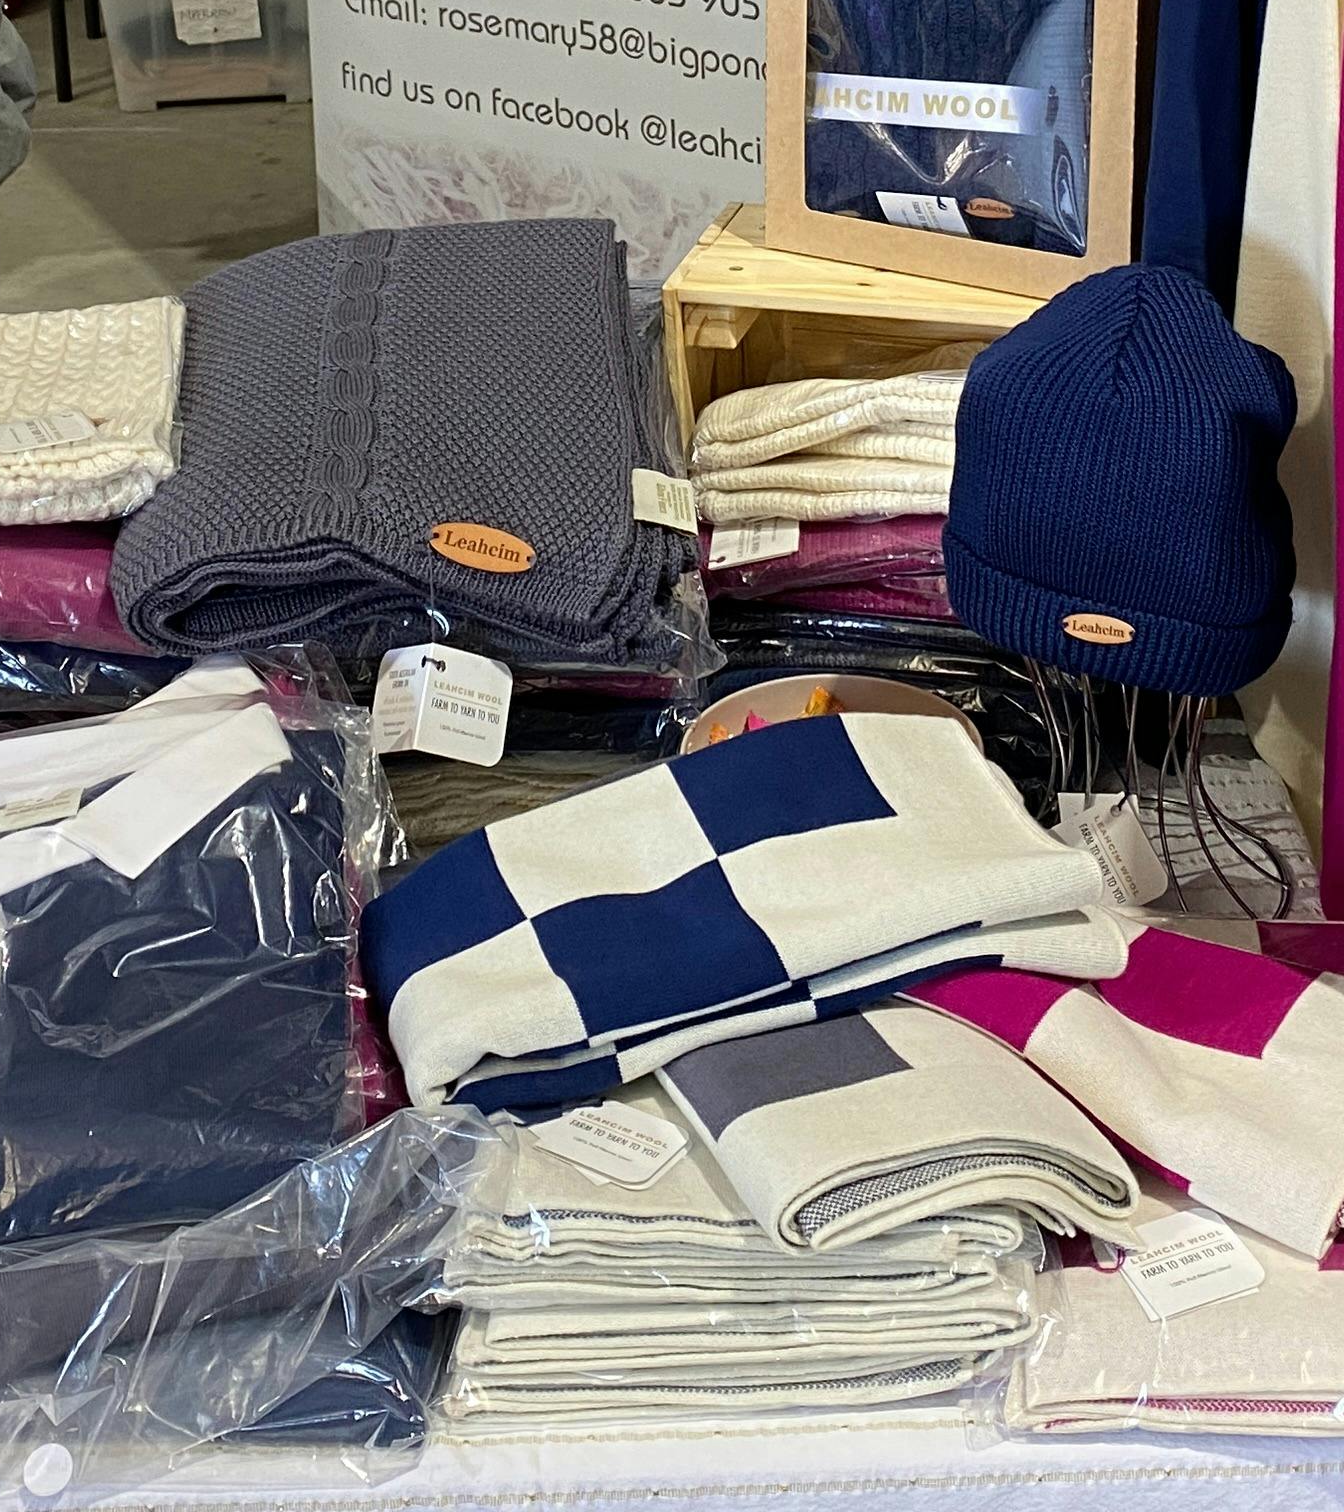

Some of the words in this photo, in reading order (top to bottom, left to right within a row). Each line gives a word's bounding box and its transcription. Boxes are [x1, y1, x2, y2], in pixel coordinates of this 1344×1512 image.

[341, 60, 393, 98] find
[402, 79, 435, 106] us
[444, 87, 482, 114] on
[491, 87, 630, 141] facebook
[922, 92, 1018, 121] WOOL
[443, 529, 521, 564] Leahcim
[1071, 619, 1126, 639] Leahcim
[433, 679, 475, 699] LEAHCIM
[477, 691, 504, 706] WOOL
[431, 696, 449, 712] FARM
[450, 701, 459, 714] TO
[460, 704, 477, 720] YARN
[478, 708, 486, 722] TO
[487, 711, 501, 726] YOU
[1094, 815, 1123, 864] LEAHCIM
[1120, 866, 1140, 897] WOOL
[568, 1119, 594, 1133] FARM
[593, 1125, 605, 1138] TO
[629, 1138, 641, 1151] TO
[641, 1145, 661, 1160] YOU
[634, 1130, 669, 1150] WOOL
[1129, 1239, 1186, 1266] LEAHCIM
[1187, 1228, 1225, 1247] WOOL
[1139, 1263, 1166, 1280] FARM
[1166, 1259, 1180, 1272] TO
[1179, 1251, 1203, 1268] YARN
[1202, 1247, 1216, 1260] TO
[1215, 1240, 1236, 1257] YOU
